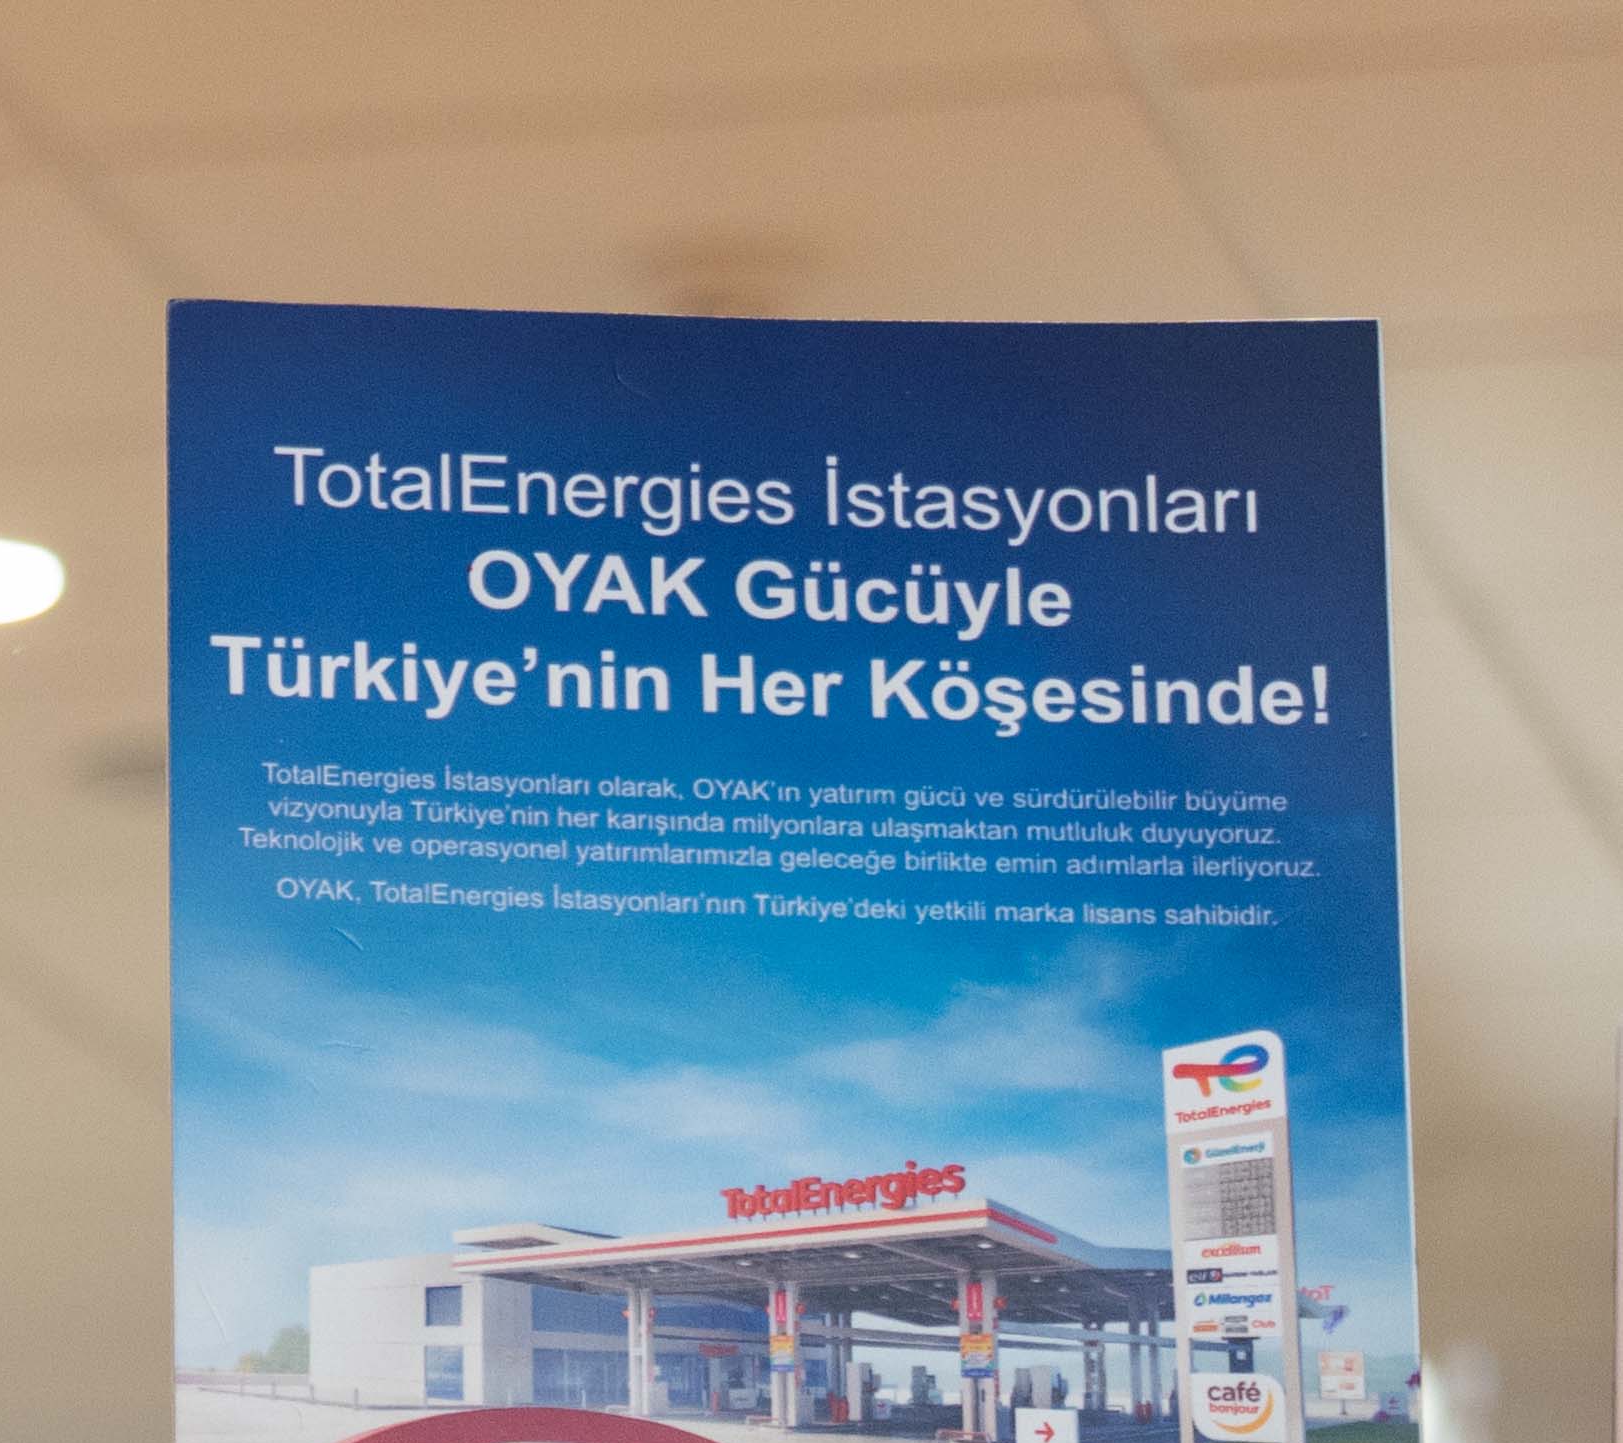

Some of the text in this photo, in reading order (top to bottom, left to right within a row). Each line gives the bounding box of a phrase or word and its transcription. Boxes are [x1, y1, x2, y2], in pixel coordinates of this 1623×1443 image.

[274, 445, 1262, 548] TotalEnergies İstasyonları
[468, 550, 1073, 639] OYAK Gücüyle
[700, 653, 843, 721] Her
[870, 659, 1332, 738] Köşesinde!
[261, 762, 436, 793] TotalEnergies
[444, 765, 590, 796] İstasyonları
[809, 784, 895, 810] yatırım
[904, 786, 966, 812] gücü
[975, 792, 1004, 808] ve
[1012, 787, 1177, 812] sürdürülebilir
[1185, 790, 1288, 818] büyüme
[268, 797, 403, 828] vizyonuyla
[557, 807, 598, 828] her
[607, 809, 725, 835] karışında
[732, 814, 864, 842] milyonlara
[872, 817, 1018, 844] ulaşmaktan
[1027, 820, 1133, 842] mutluluk
[1141, 822, 1282, 850] duyuyoruz.
[238, 826, 1322, 882] Teknolojik ve operasyonel yatırımlarımızla geleceğe birlikte emin adımlarla ilerliyoruz.
[369, 880, 545, 912] TotalEnergies
[914, 898, 987, 923] yetkili
[996, 903, 1074, 925] marka
[1083, 903, 1156, 926] lisans
[1165, 904, 1279, 928] sahibidir.
[1175, 1098, 1271, 1124] TotalEnergies
[721, 1160, 965, 1219] TotalEnergies
[1207, 1380, 1261, 1402] café
[1209, 1403, 1259, 1416] bonjour
